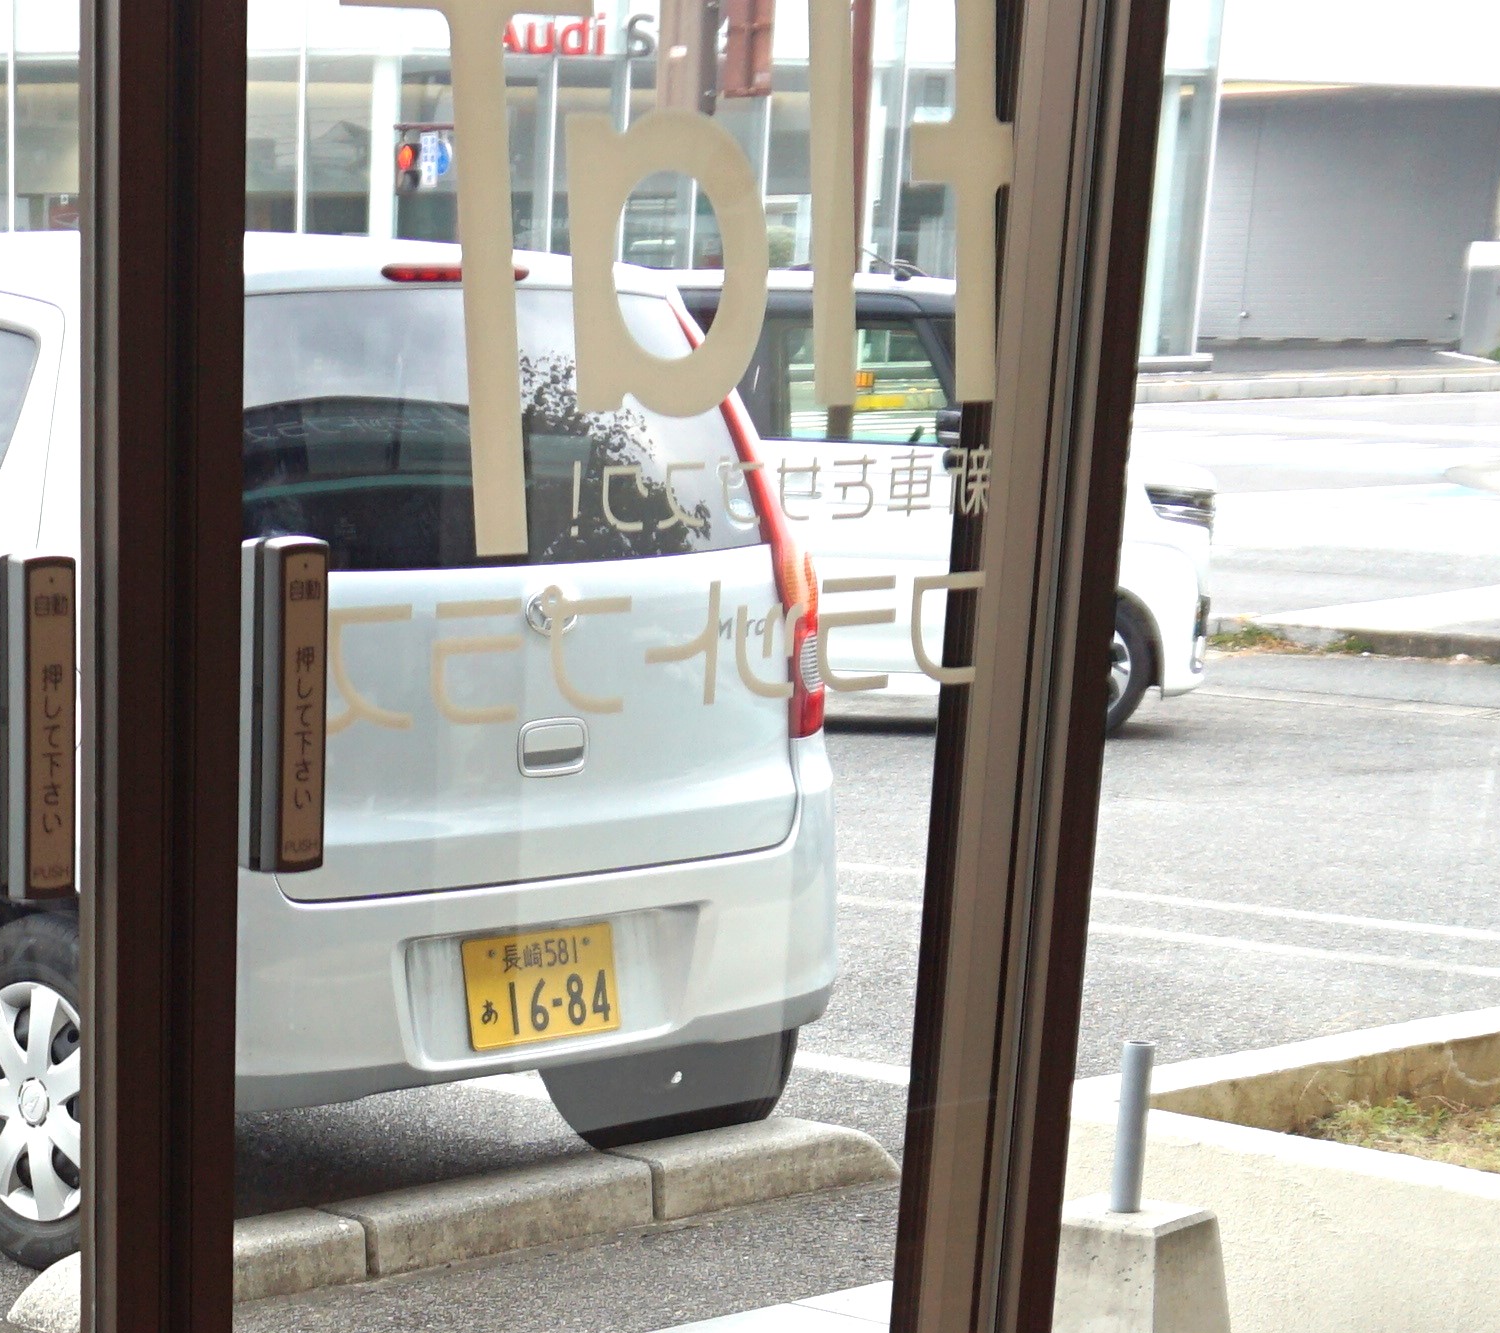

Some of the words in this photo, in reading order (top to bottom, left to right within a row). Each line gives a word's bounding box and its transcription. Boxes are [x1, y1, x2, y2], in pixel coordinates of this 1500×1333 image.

[289, 580, 322, 602] 自動
[34, 593, 69, 617] 自動
[294, 646, 315, 810] 押して下さい
[41, 664, 63, 833] 押して下さい
[285, 839, 319, 855] PUSH
[33, 864, 70, 880] PUSH
[481, 999, 499, 1025] あ
[508, 968, 612, 1036] 16-84
